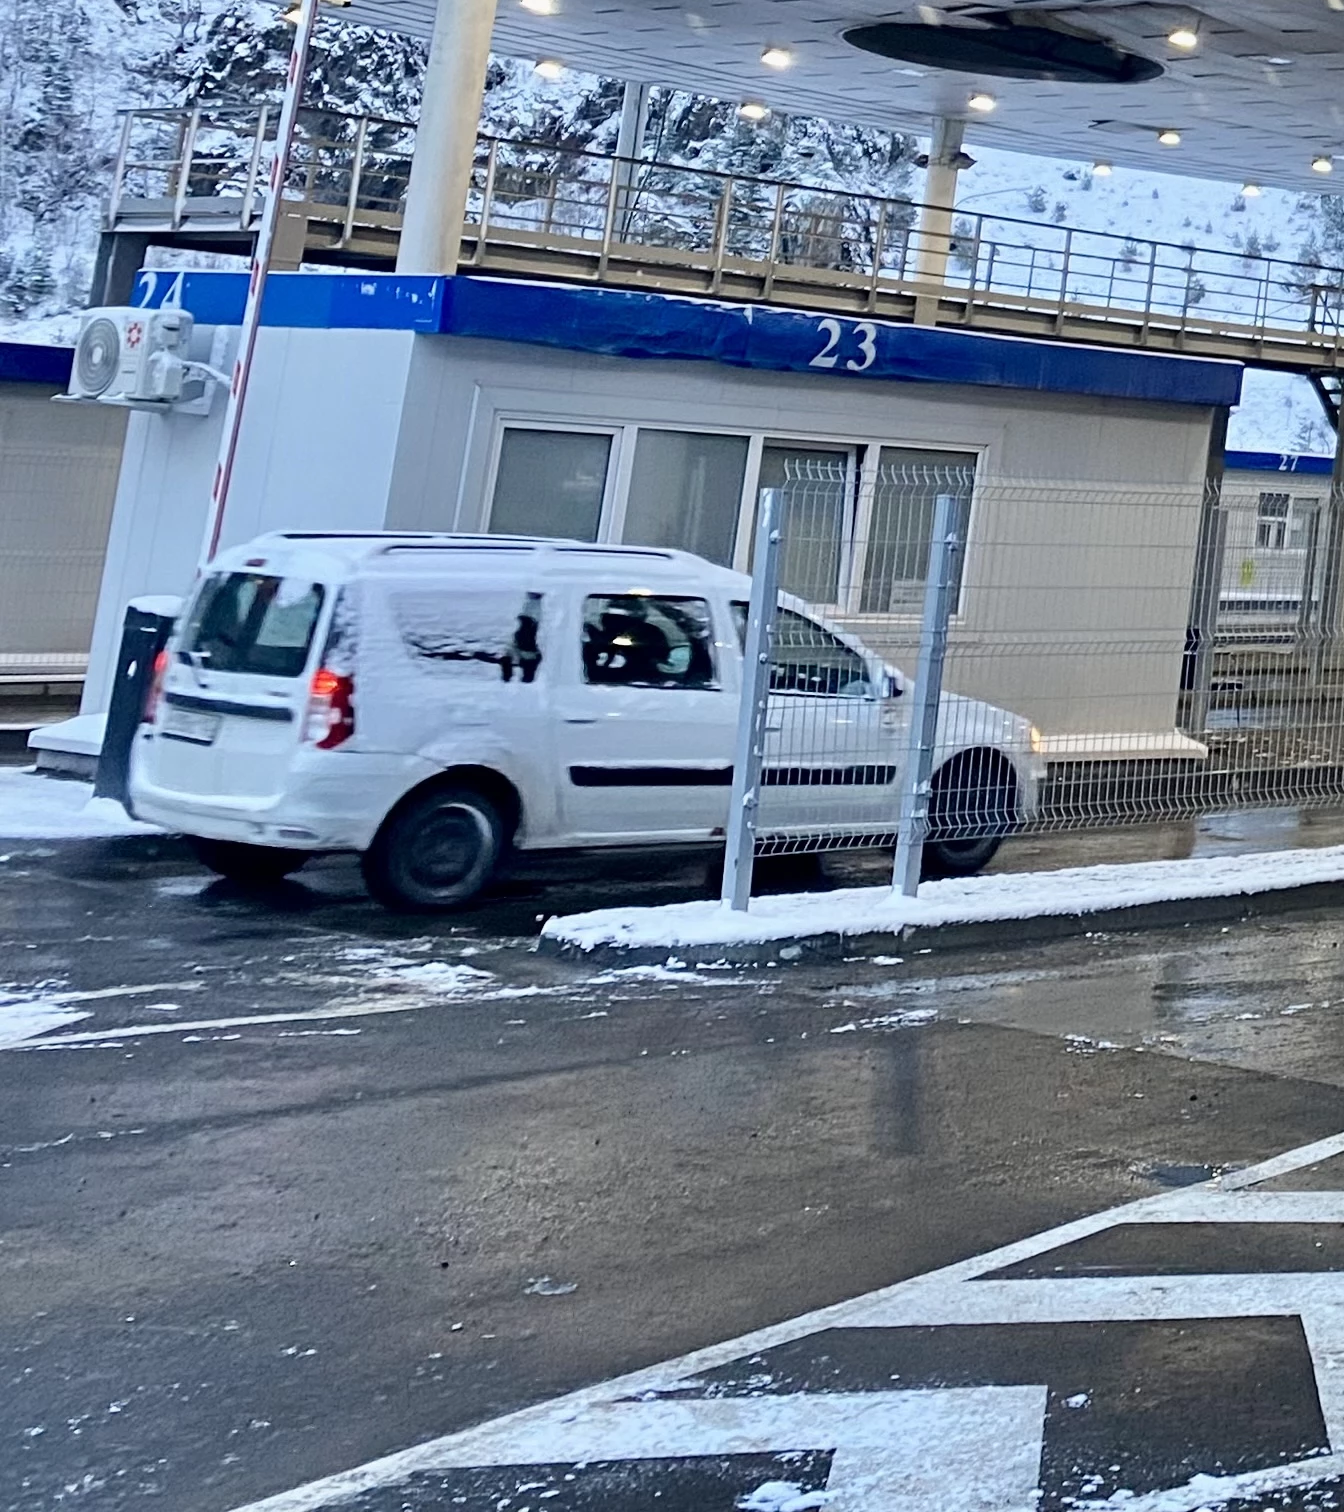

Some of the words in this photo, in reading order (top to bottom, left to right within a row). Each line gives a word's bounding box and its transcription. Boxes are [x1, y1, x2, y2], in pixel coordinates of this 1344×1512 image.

[139, 272, 184, 309] 24
[808, 318, 877, 372] 23
[1278, 454, 1299, 472] 27
